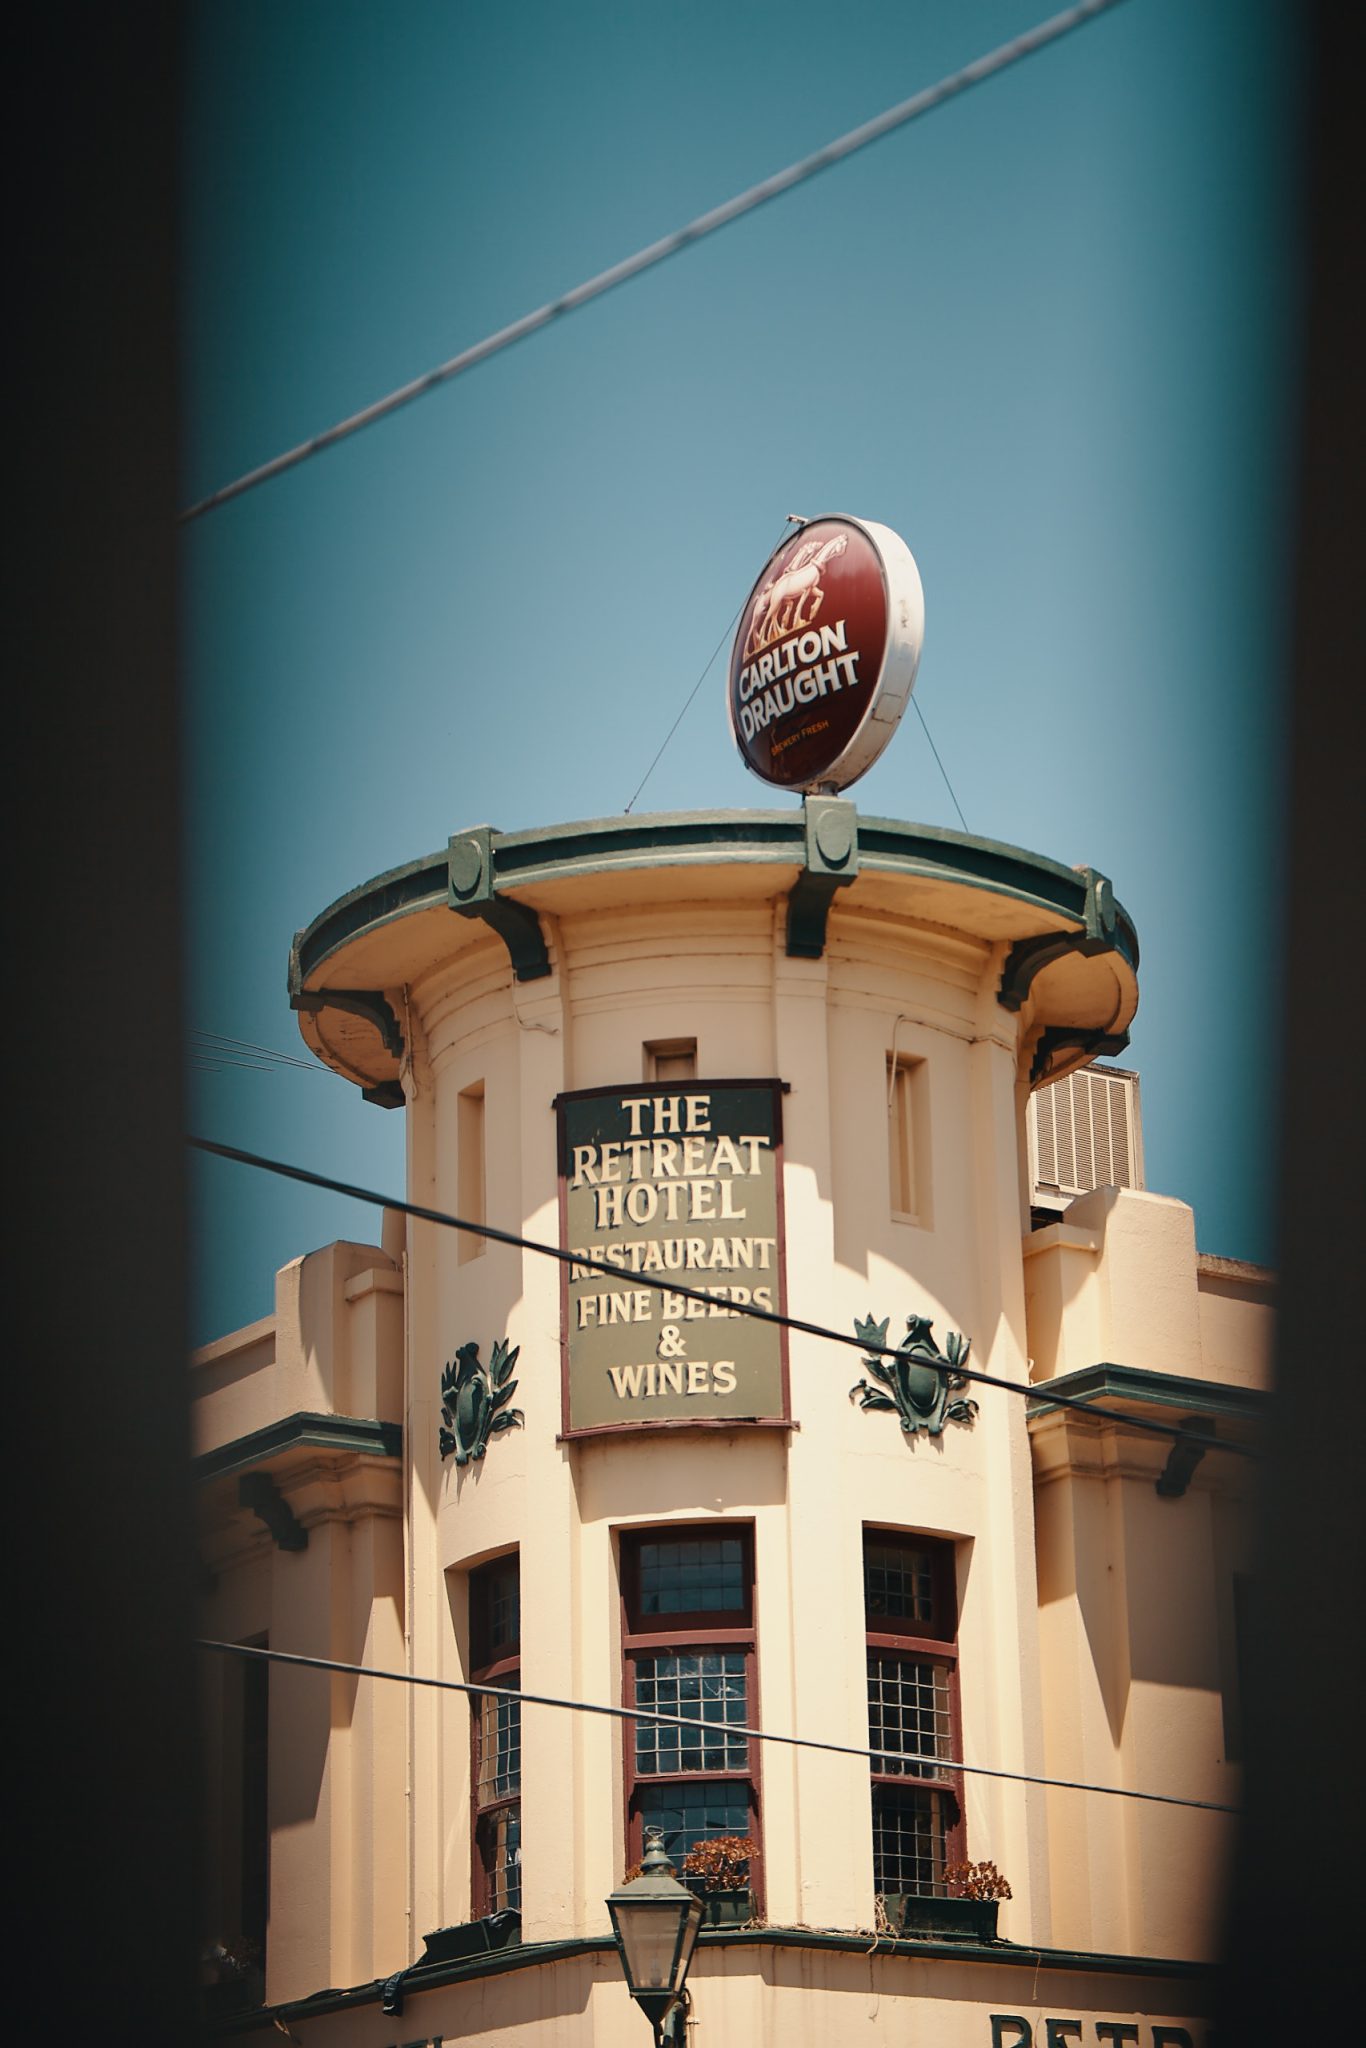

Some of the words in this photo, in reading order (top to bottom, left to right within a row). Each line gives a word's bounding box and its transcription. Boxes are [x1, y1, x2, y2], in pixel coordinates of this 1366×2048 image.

[739, 619, 848, 702] CARLTON
[740, 651, 860, 744] DRAUGHT
[800, 720, 831, 737] FRESH
[621, 1095, 711, 1136] THE
[571, 1135, 770, 1188] RETREAT
[596, 1179, 747, 1228] HOTEL
[569, 1237, 776, 1281] RESTAURANT
[578, 1289, 652, 1328] FINE
[662, 1286, 773, 1321] BEERS
[657, 1324, 688, 1358] &
[608, 1360, 738, 1399] WINES
